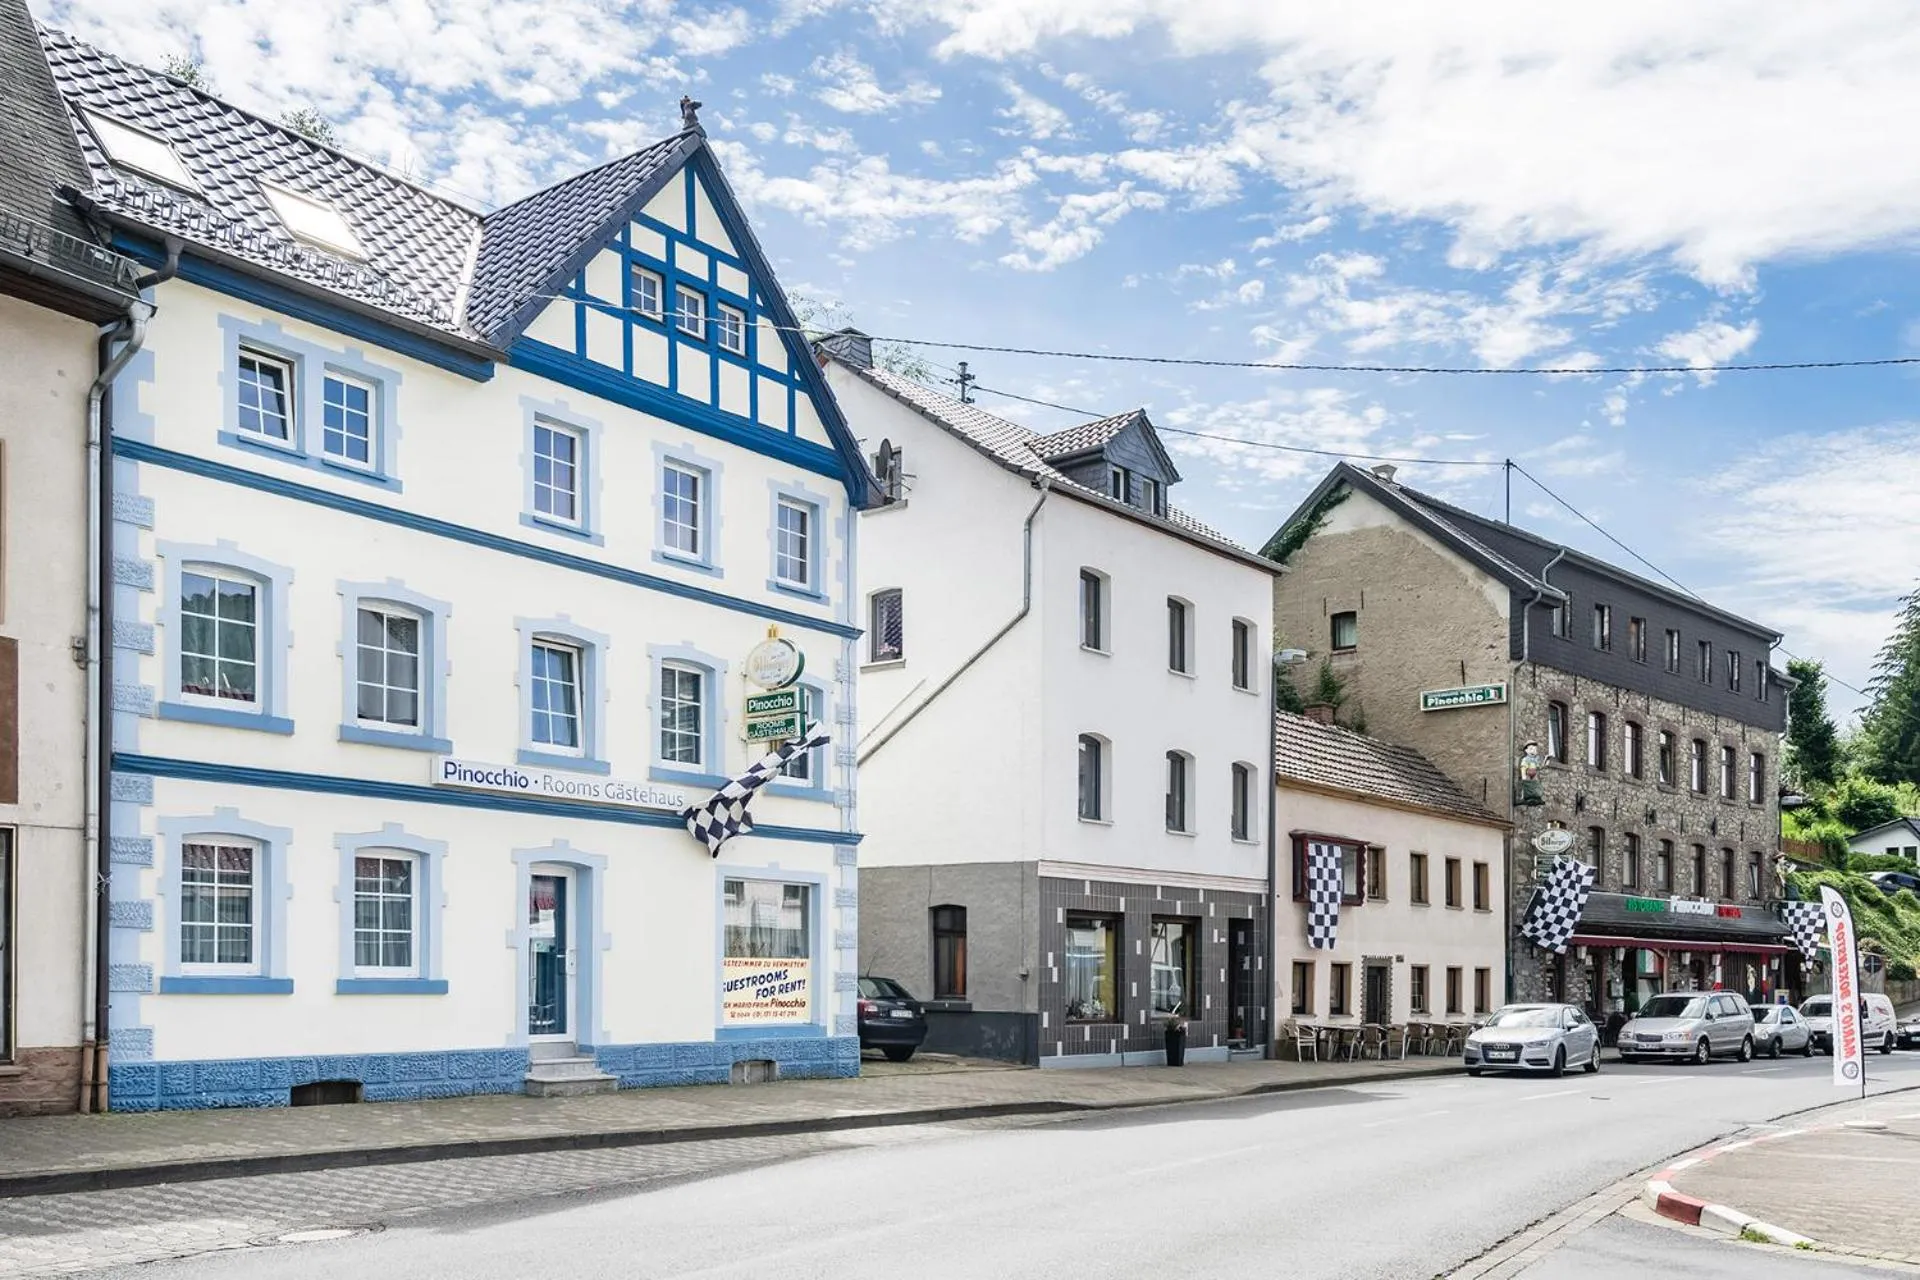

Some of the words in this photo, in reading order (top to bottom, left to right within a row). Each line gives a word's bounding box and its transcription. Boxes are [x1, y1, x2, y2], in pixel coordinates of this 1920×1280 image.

[749, 694, 793, 711] Pinocchio
[1427, 694, 1483, 706] Pinocchio
[756, 719, 785, 729] ROOMS
[443, 760, 529, 788] Pinocchio
[543, 775, 599, 797] Rooms
[604, 783, 683, 807] Gästehaus
[756, 986, 776, 999] FOR
[778, 979, 806, 994] RENT!
[770, 998, 806, 1008] Pinocchio
